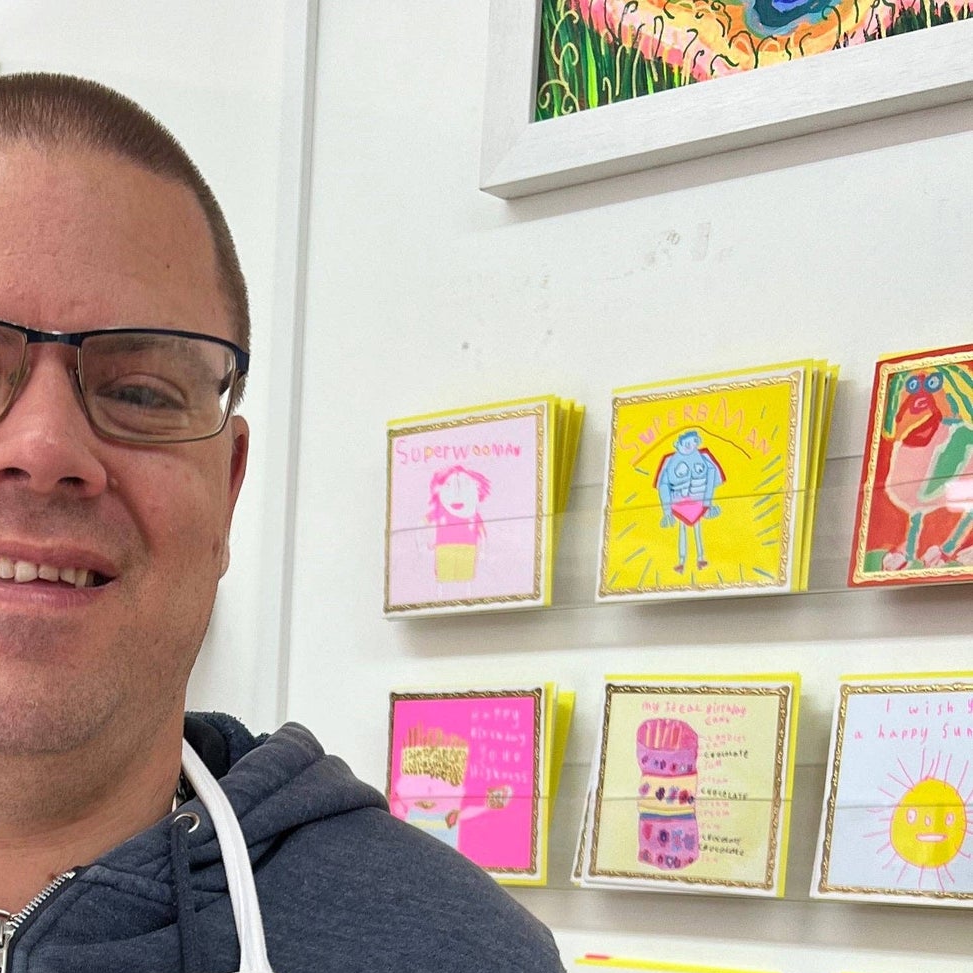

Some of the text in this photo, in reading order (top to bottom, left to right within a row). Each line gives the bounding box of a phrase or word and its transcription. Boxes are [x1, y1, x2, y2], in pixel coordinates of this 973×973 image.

[908, 700, 954, 716] wish
[878, 723, 928, 745] happy
[942, 722, 973, 739] Sun
